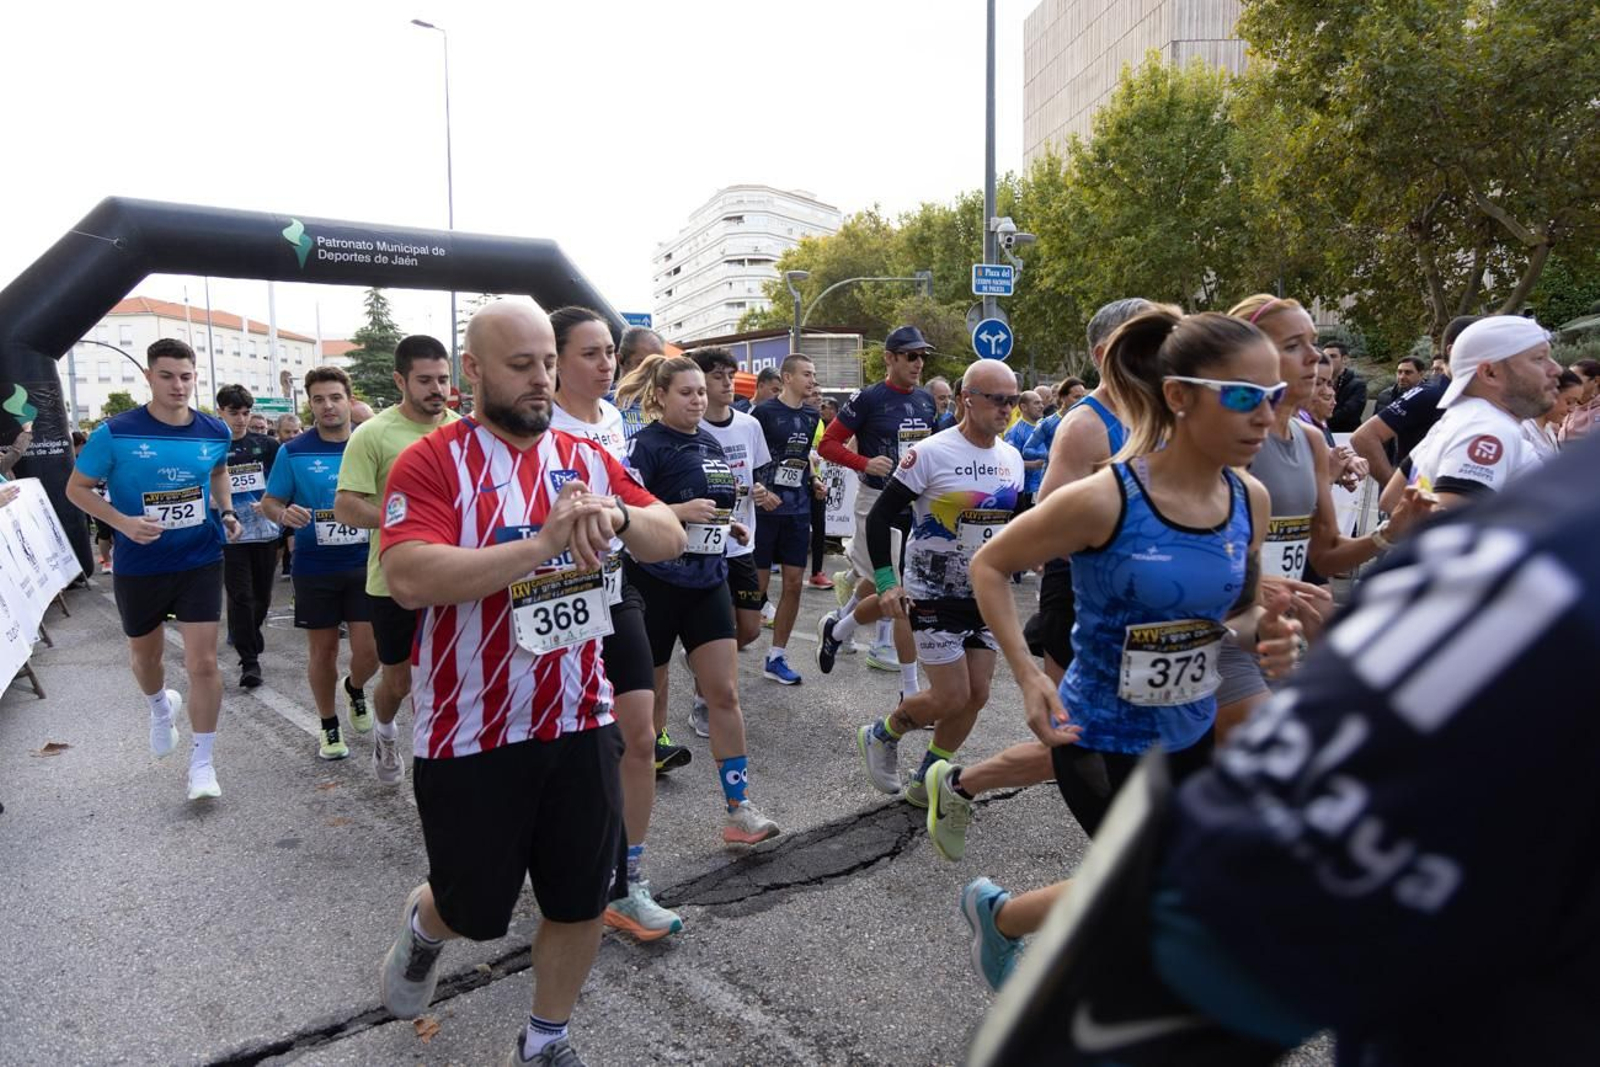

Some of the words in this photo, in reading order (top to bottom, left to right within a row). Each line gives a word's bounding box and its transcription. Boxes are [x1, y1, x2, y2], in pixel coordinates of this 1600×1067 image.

[317, 236, 374, 251] Patronato
[376, 241, 429, 257] Municipal
[431, 246, 446, 257] de
[318, 249, 372, 263] Deportes
[374, 253, 389, 264] de
[391, 255, 418, 267] Jaén
[985, 268, 1000, 278] Plaza
[1002, 269, 1010, 277] del
[899, 418, 928, 431] 25
[787, 432, 808, 444] 25
[701, 459, 731, 473] 25
[231, 475, 256, 487] 255
[782, 469, 798, 481] 705
[158, 504, 195, 521] 752
[704, 528, 722, 545] 75
[1282, 544, 1304, 572] 56
[511, 580, 532, 599] XXV
[541, 580, 562, 594] gran
[564, 573, 600, 586] caminata
[533, 598, 590, 635] 368
[1132, 629, 1159, 642] XXV
[1147, 652, 1206, 688] 373
